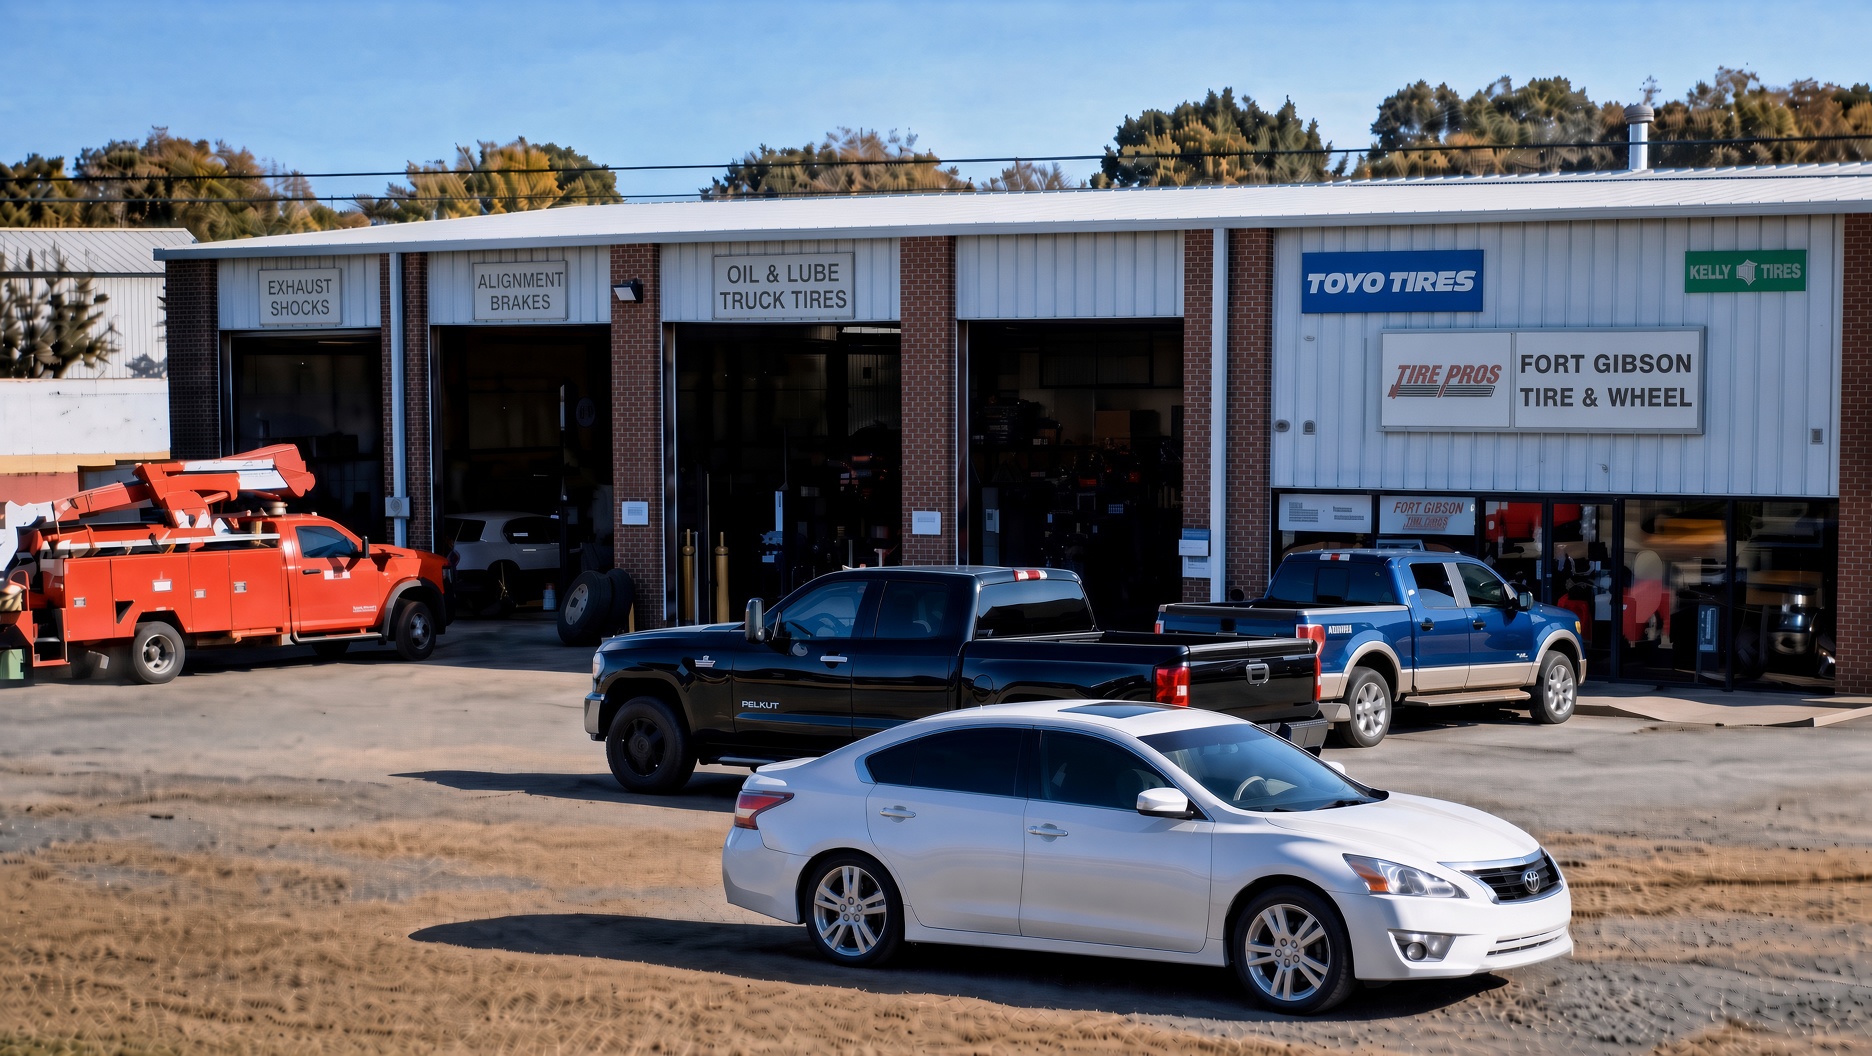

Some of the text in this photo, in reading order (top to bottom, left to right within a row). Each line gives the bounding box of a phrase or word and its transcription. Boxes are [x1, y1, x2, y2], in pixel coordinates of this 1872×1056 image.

[477, 270, 564, 290] ALIGNMENT
[727, 263, 840, 284] OIL & LUBE
[1307, 270, 1476, 294] TOYO TIRES
[1689, 263, 1801, 281] KELLY TIRES
[268, 278, 332, 296] EXHAUST
[270, 299, 330, 317] SHOCKS
[490, 293, 551, 311] BRAKES
[719, 289, 847, 310] TRUCK TIRES
[1520, 353, 1692, 374] FORT GIBSON
[1389, 364, 1502, 399] TIRE PROS
[1520, 387, 1693, 408] TIRE & WHEEL
[1393, 501, 1465, 515] FORT GIBSON
[741, 700, 780, 710] PELKUT
